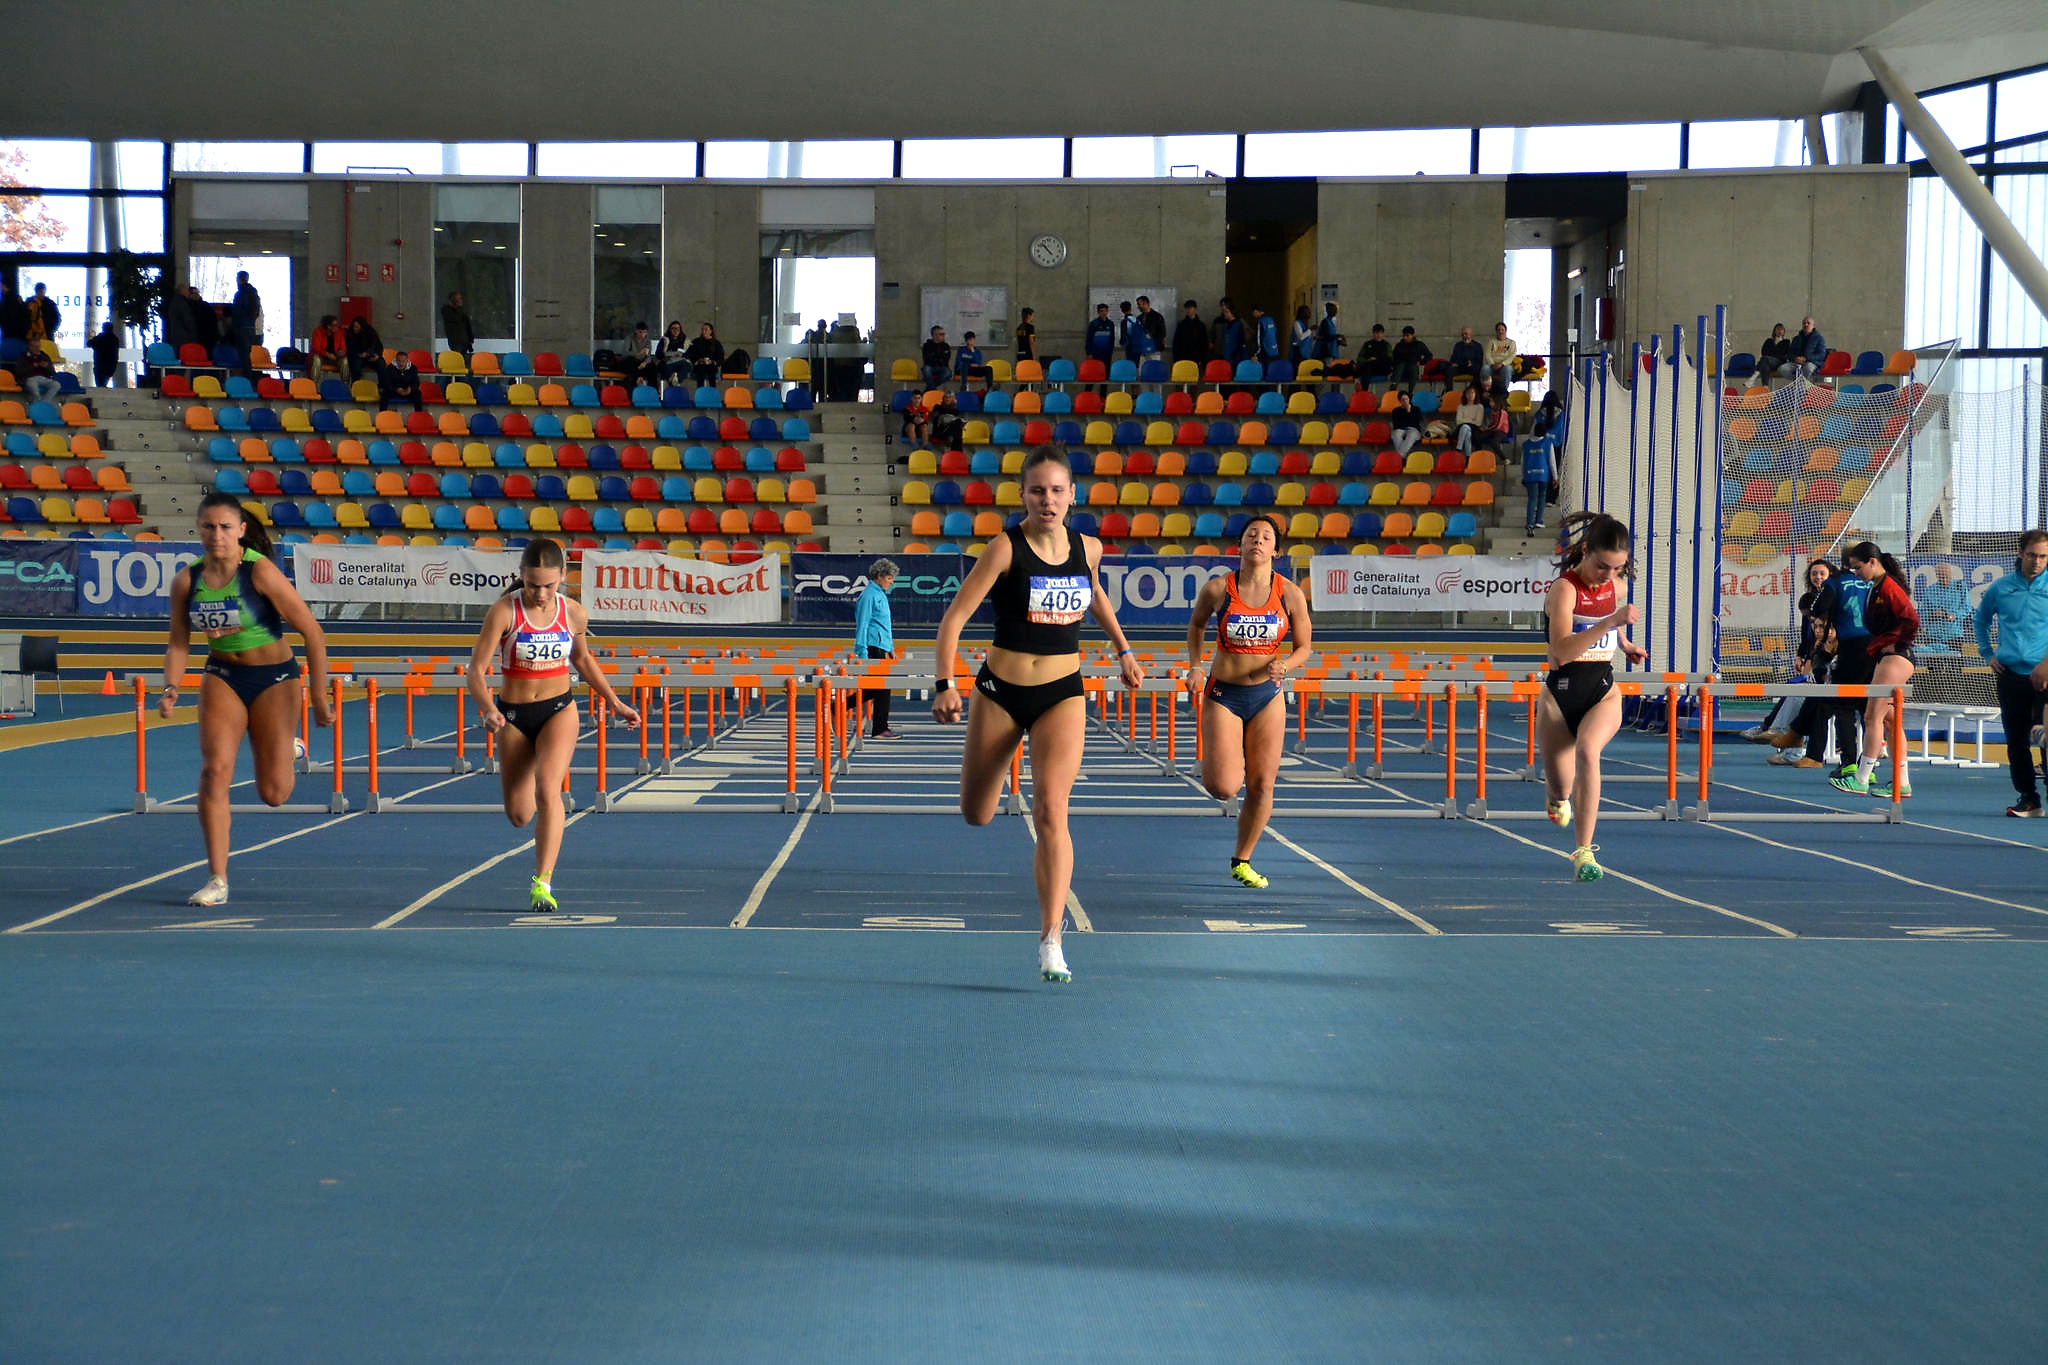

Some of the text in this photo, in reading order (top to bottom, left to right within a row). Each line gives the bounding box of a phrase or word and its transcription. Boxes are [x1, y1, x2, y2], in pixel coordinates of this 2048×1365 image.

[338, 562, 405, 573] Generalitat
[338, 575, 417, 588] de Catalunya
[594, 563, 770, 596] mutuacat
[1353, 570, 1421, 583] Generalitat
[1353, 584, 1431, 599] de Catalunya
[592, 597, 707, 616] ASSEGURANCES
[1040, 590, 1082, 611] 406
[197, 611, 232, 629] 362
[1235, 624, 1269, 639] 402
[525, 643, 562, 660] 346
